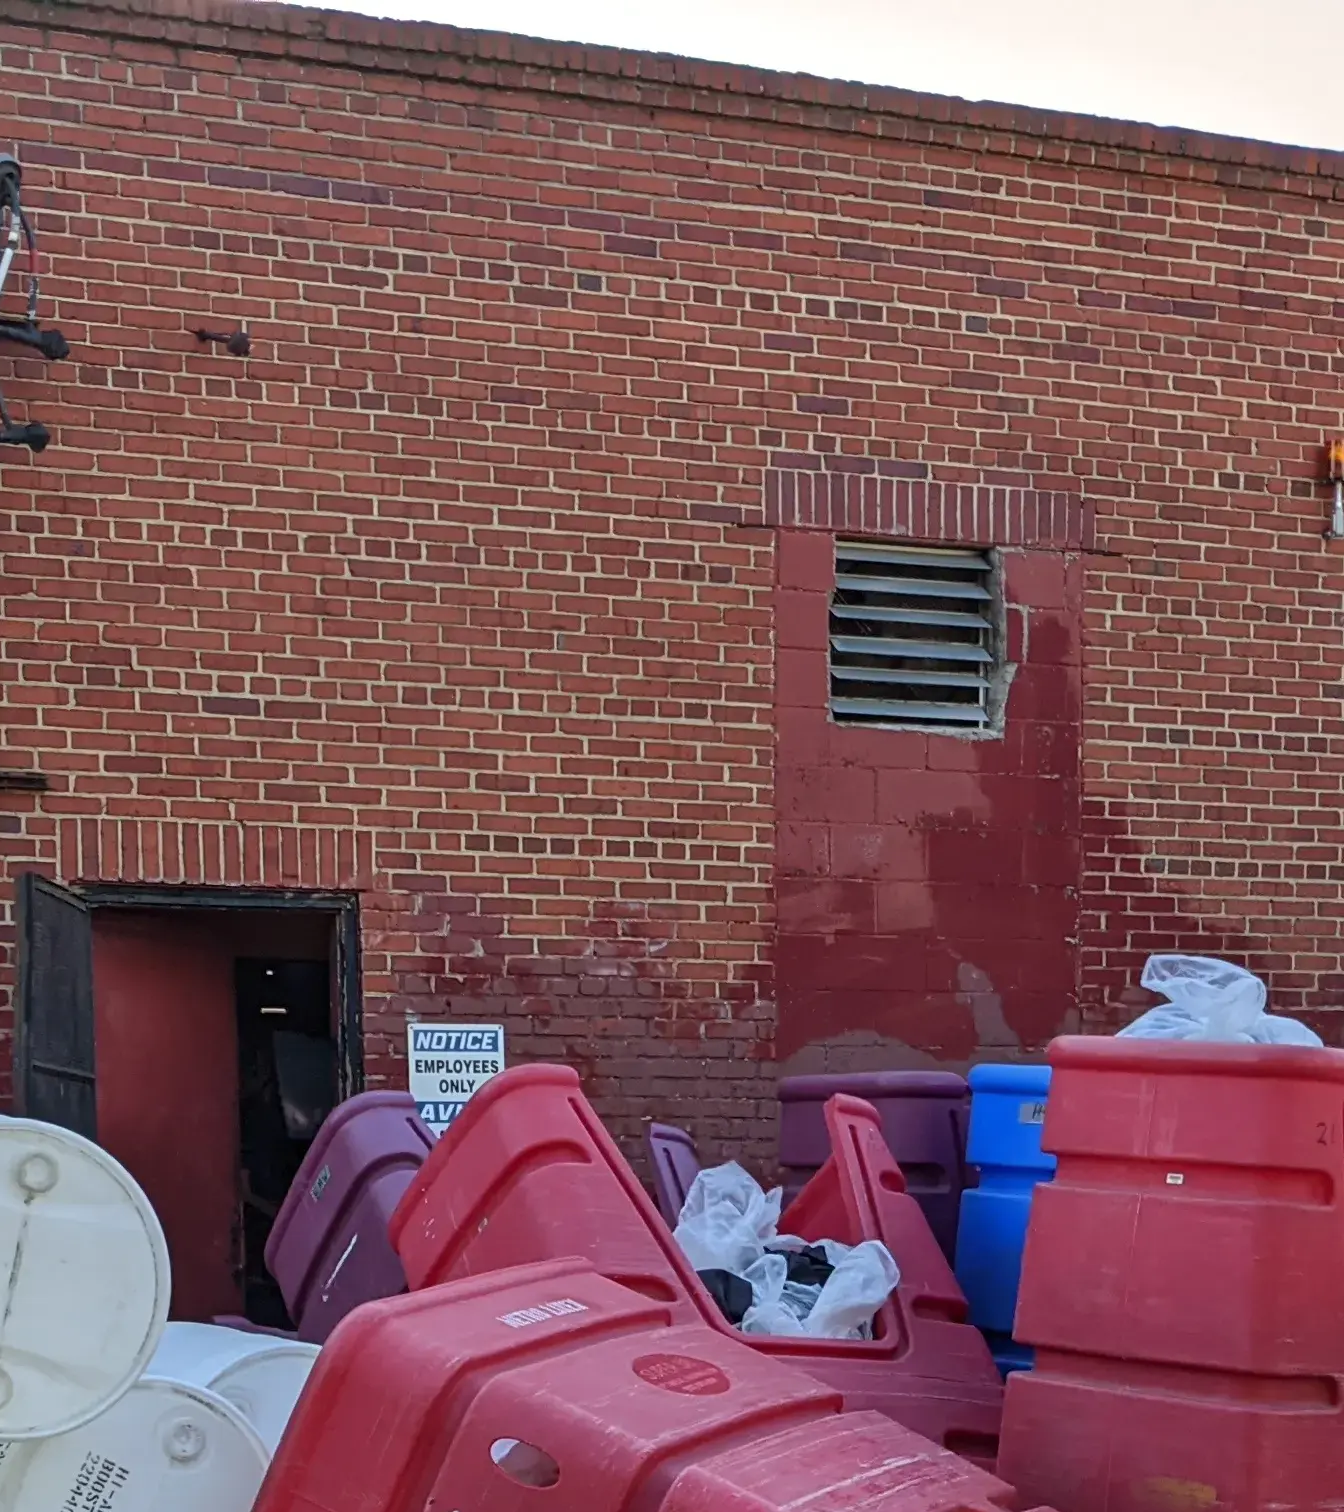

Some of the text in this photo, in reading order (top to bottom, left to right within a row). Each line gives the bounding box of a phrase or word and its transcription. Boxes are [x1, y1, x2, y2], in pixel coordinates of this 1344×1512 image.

[415, 1031, 496, 1050] NOTICE
[414, 1059, 499, 1074] EMPLOYEES
[438, 1079, 476, 1093] ONLY
